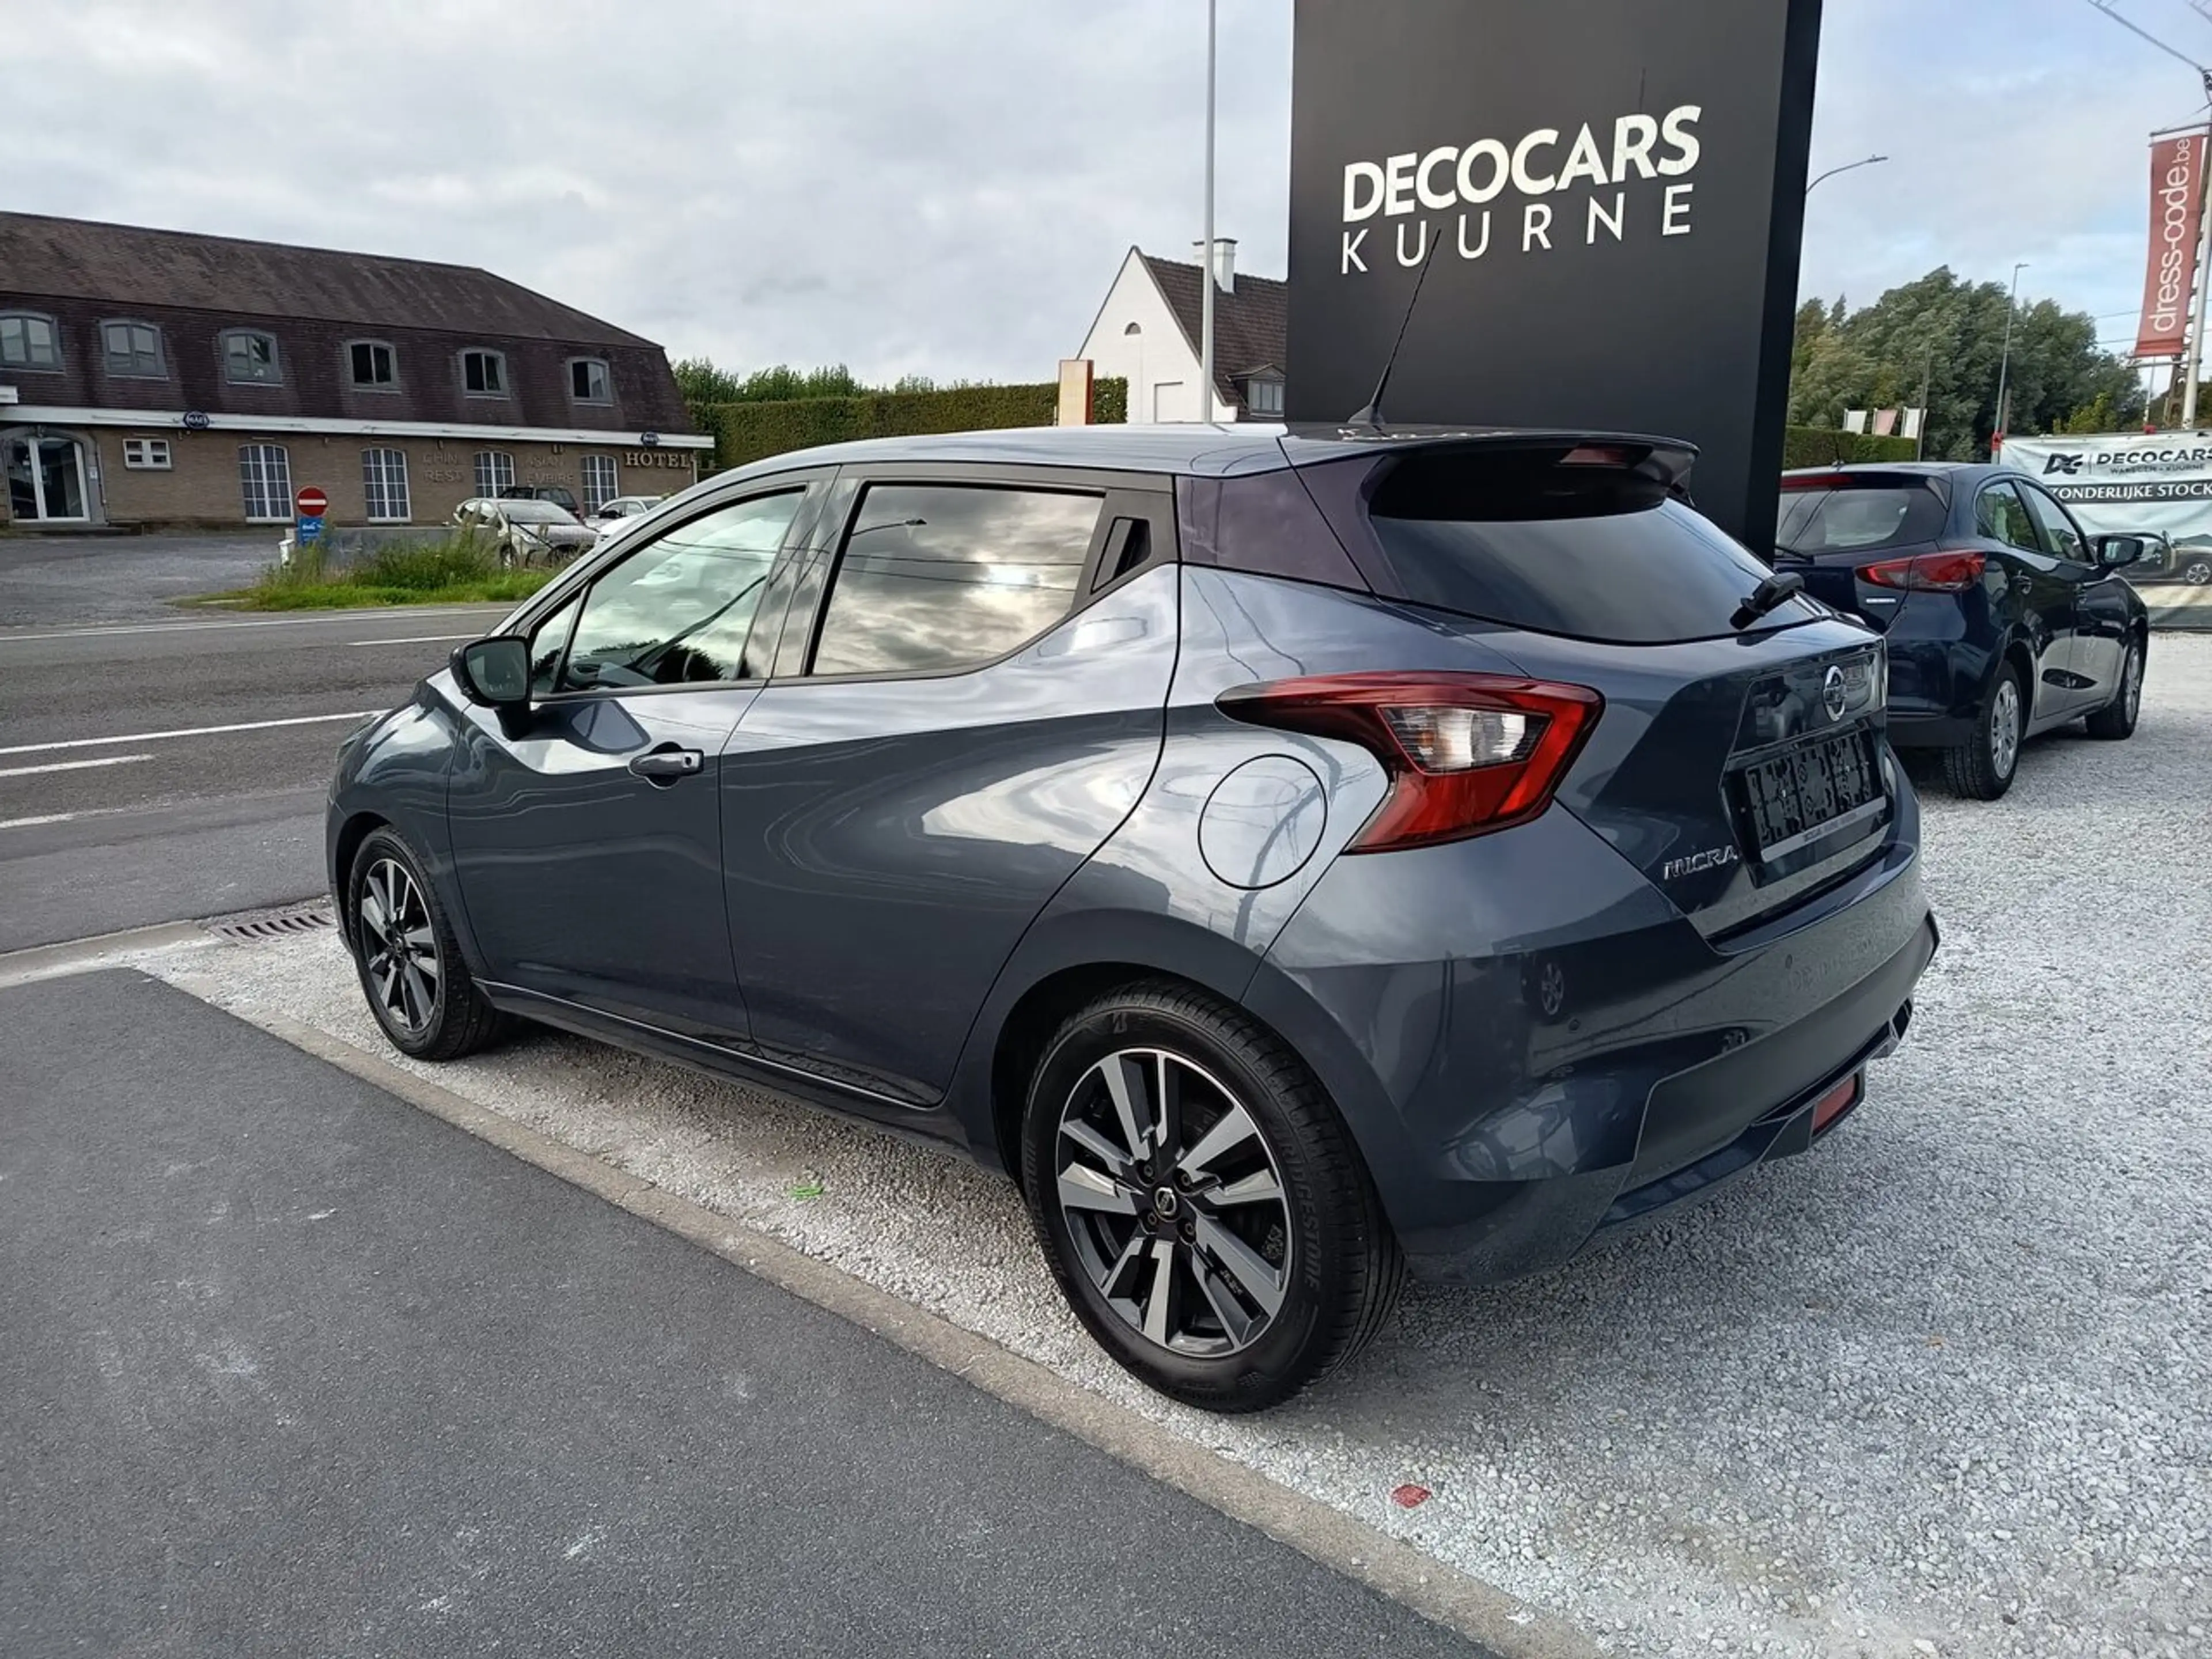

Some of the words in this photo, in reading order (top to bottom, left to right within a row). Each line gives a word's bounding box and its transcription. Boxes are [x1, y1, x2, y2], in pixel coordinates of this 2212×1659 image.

[1343, 105, 1702, 223] DECOCARS
[1341, 183, 1694, 274] KUURNE
[2149, 138, 2191, 332] dress-code.be
[624, 452, 691, 468] HOTEL
[2157, 483, 2212, 498] STOCK
[1664, 844, 1738, 880] MICRA
